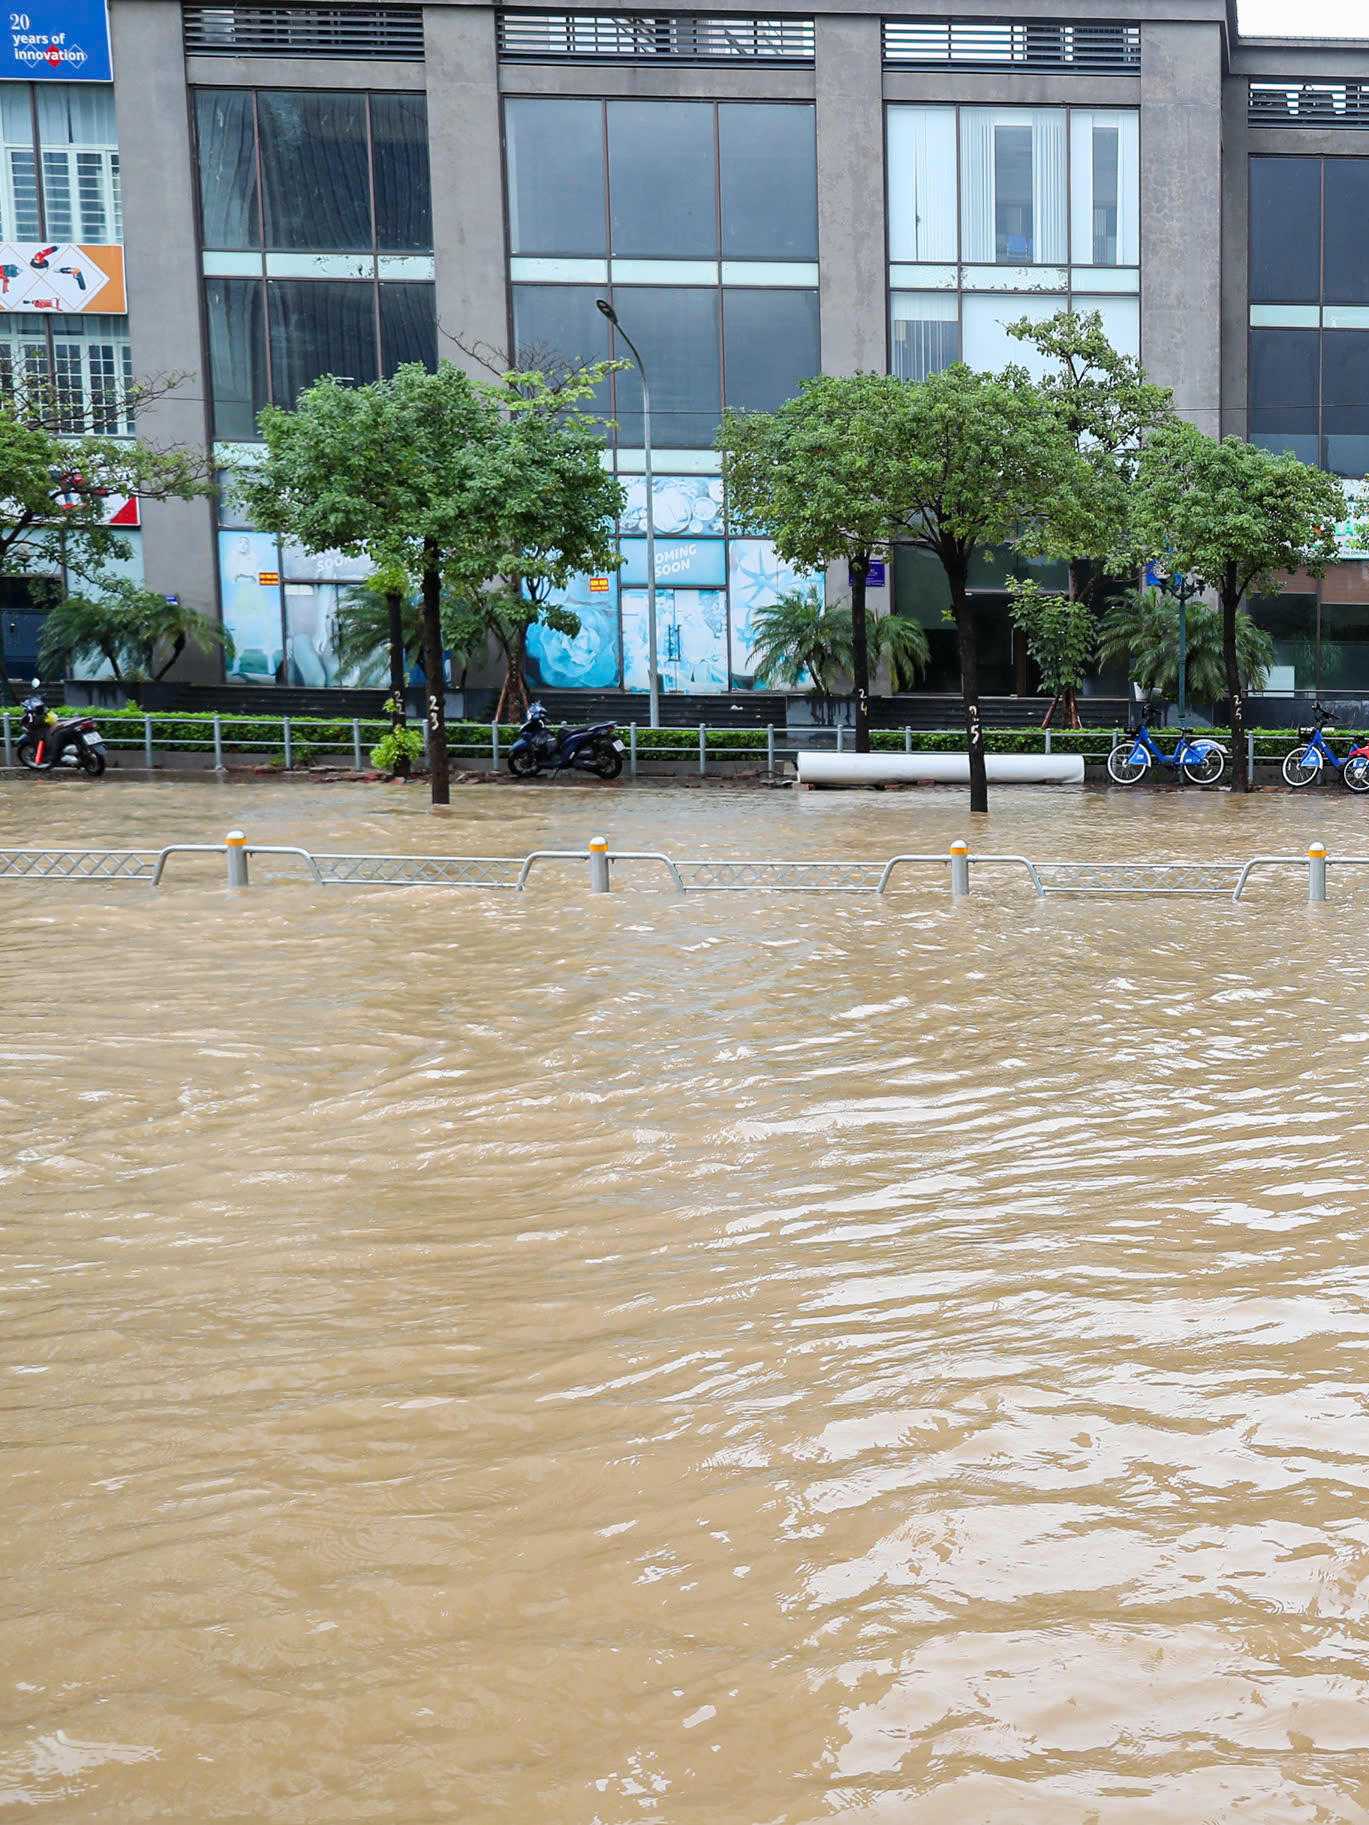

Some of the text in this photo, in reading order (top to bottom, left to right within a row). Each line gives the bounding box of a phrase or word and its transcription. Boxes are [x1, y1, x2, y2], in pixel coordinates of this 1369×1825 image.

[9, 13, 30, 31] 20
[12, 32, 66, 47] years of
[15, 48, 85, 61] innovation
[654, 543, 697, 564] OMING
[654, 558, 691, 578] SOON
[429, 695, 440, 730] 23
[968, 705, 980, 744] 25
